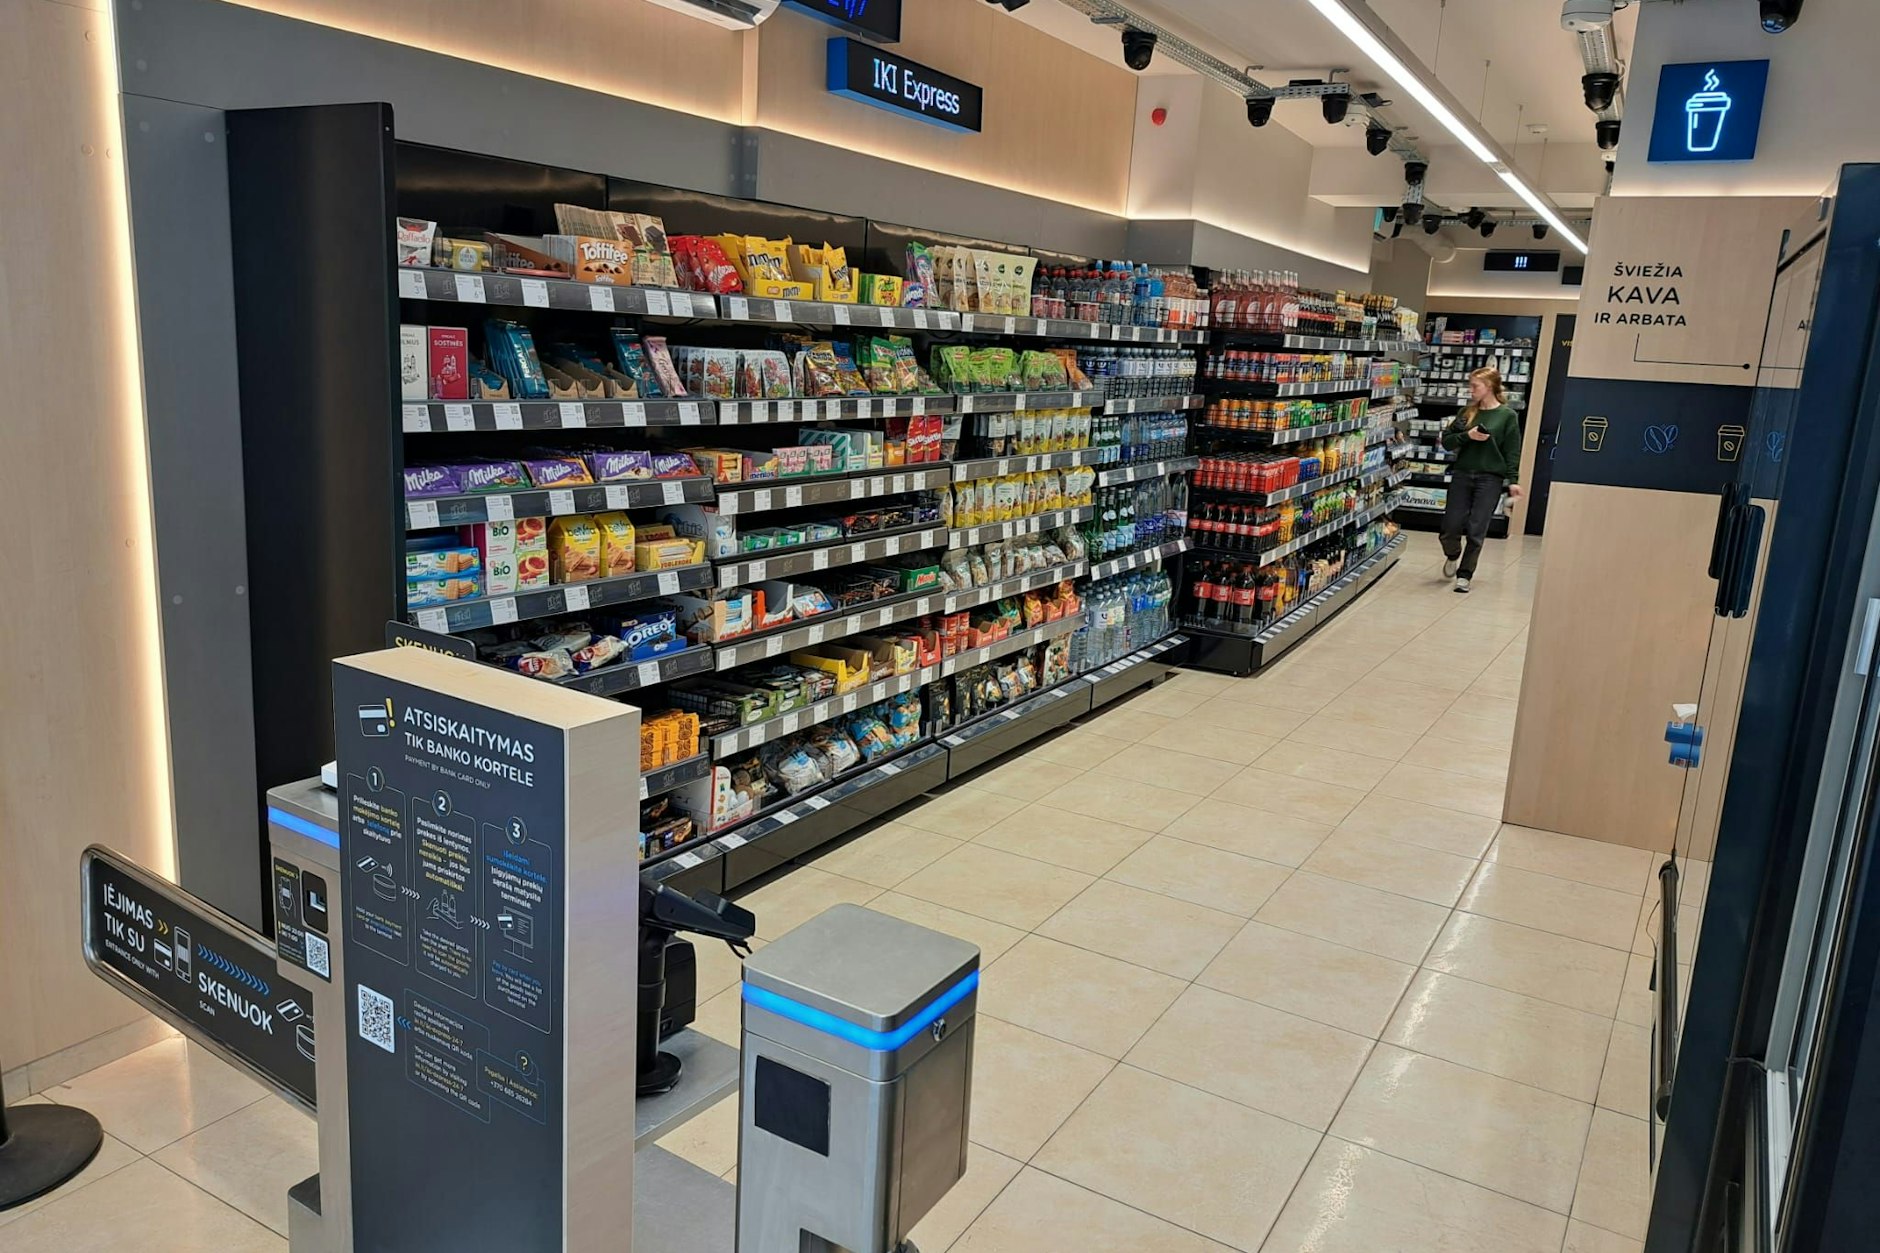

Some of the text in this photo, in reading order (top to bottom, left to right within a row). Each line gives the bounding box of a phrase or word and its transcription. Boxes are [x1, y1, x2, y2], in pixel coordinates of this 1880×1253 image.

[873, 57, 960, 115] IKI Express
[580, 241, 629, 265] Toffifee
[1613, 261, 1683, 278] ŠVIEŽIA
[1607, 285, 1680, 305] KAVA
[1594, 312, 1687, 327] IR ARBATA
[606, 453, 635, 473] Milka
[654, 453, 681, 471] Milka
[405, 469, 443, 491] Milka
[469, 464, 505, 484] Milka
[541, 464, 572, 481] Milka
[628, 622, 669, 646] OREO
[404, 706, 534, 763] ATSISKAITYMAS
[404, 732, 534, 787] TIK BANKO KORTELE
[372, 772, 378, 786] 1
[405, 754, 491, 789] PAYMENT BY BANK CARD ONLY
[438, 796, 446, 811] 2
[352, 815, 365, 824] arba
[390, 829, 402, 839] prie
[416, 828, 437, 841] prekes
[447, 829, 472, 844] norimas
[512, 822, 520, 838] 3
[422, 860, 437, 872] jums
[459, 863, 471, 874] bus
[104, 912, 145, 952] TIK SU
[105, 939, 160, 980] ENTRANCE ONLY WITH
[198, 972, 273, 1035] SKENUOK
[199, 1000, 216, 1016] SCAN
